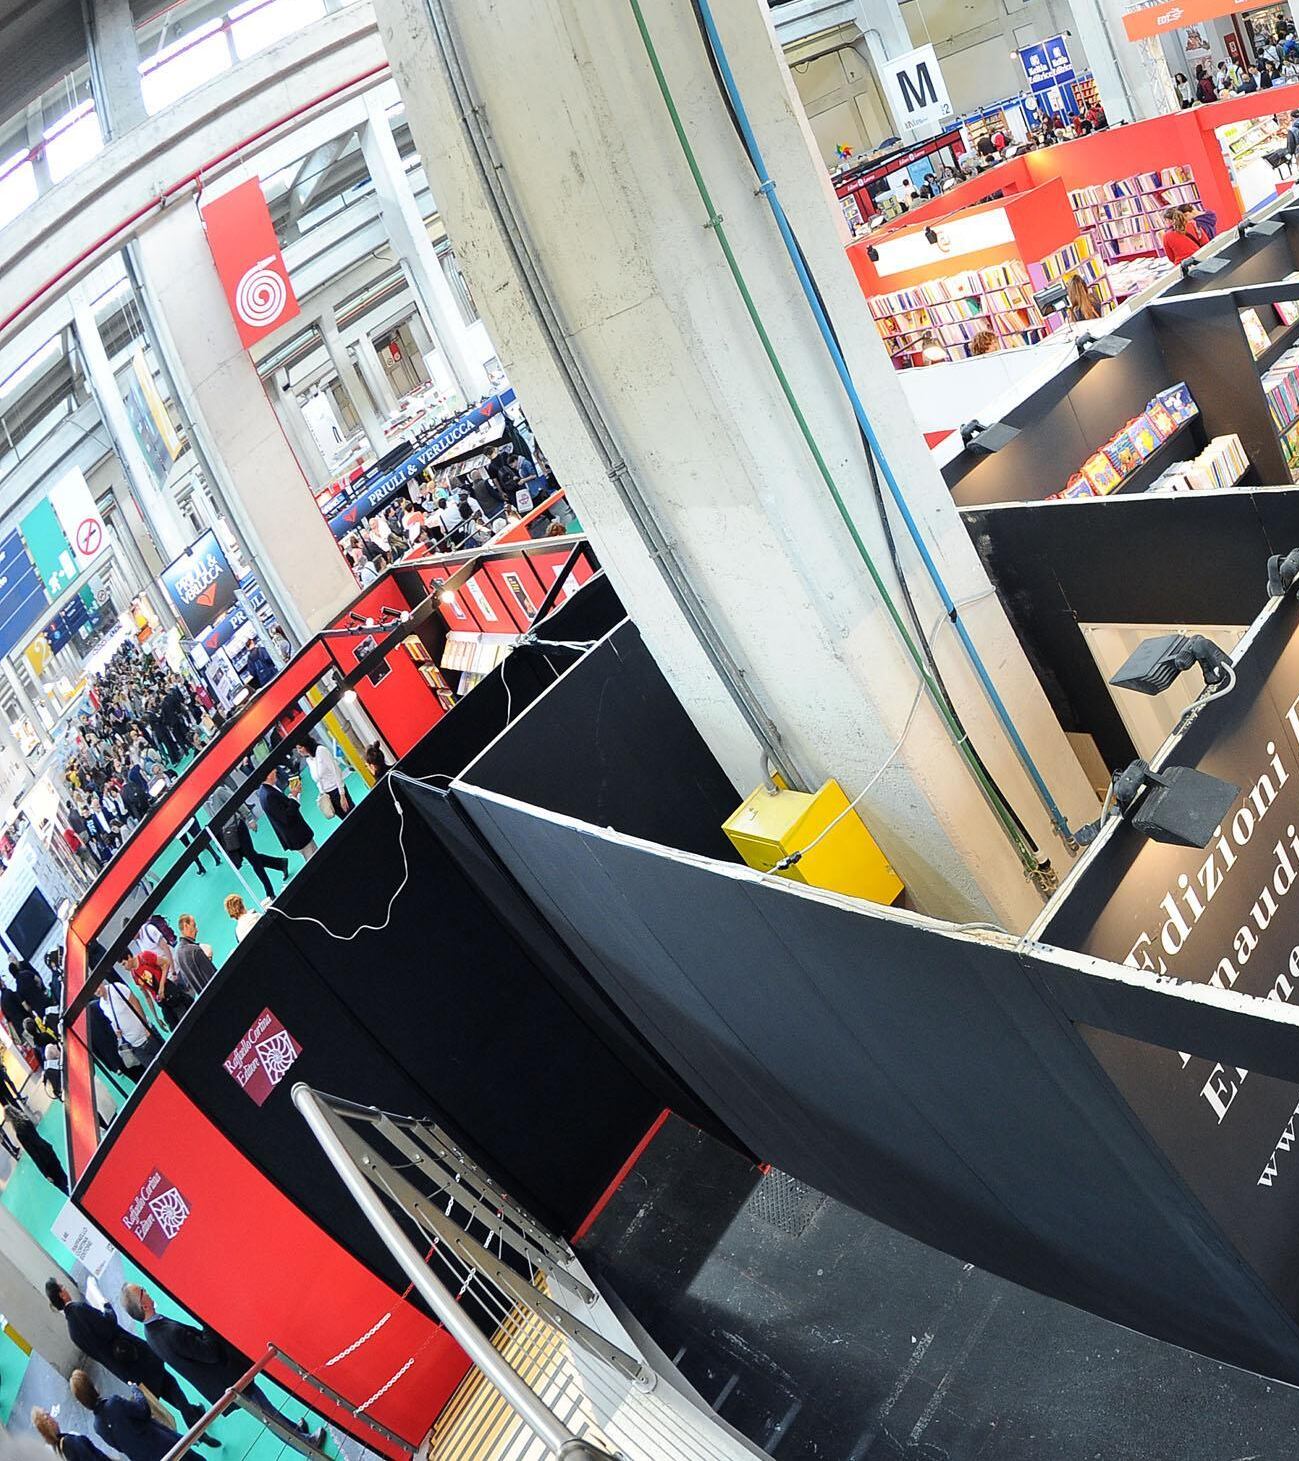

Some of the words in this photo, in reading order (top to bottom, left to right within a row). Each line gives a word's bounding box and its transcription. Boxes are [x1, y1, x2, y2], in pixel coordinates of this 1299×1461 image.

[896, 61, 939, 113] M
[943, 103, 951, 115] 2
[367, 469, 406, 507] PRIULI
[407, 463, 419, 476] &
[417, 419, 476, 466] VERLUCCA
[180, 563, 224, 605] VERLUCCA
[1122, 741, 1291, 976] Edizioni
[223, 1039, 252, 1075] Raffaello
[247, 1013, 272, 1045] Cortina
[236, 1057, 261, 1088] Editore
